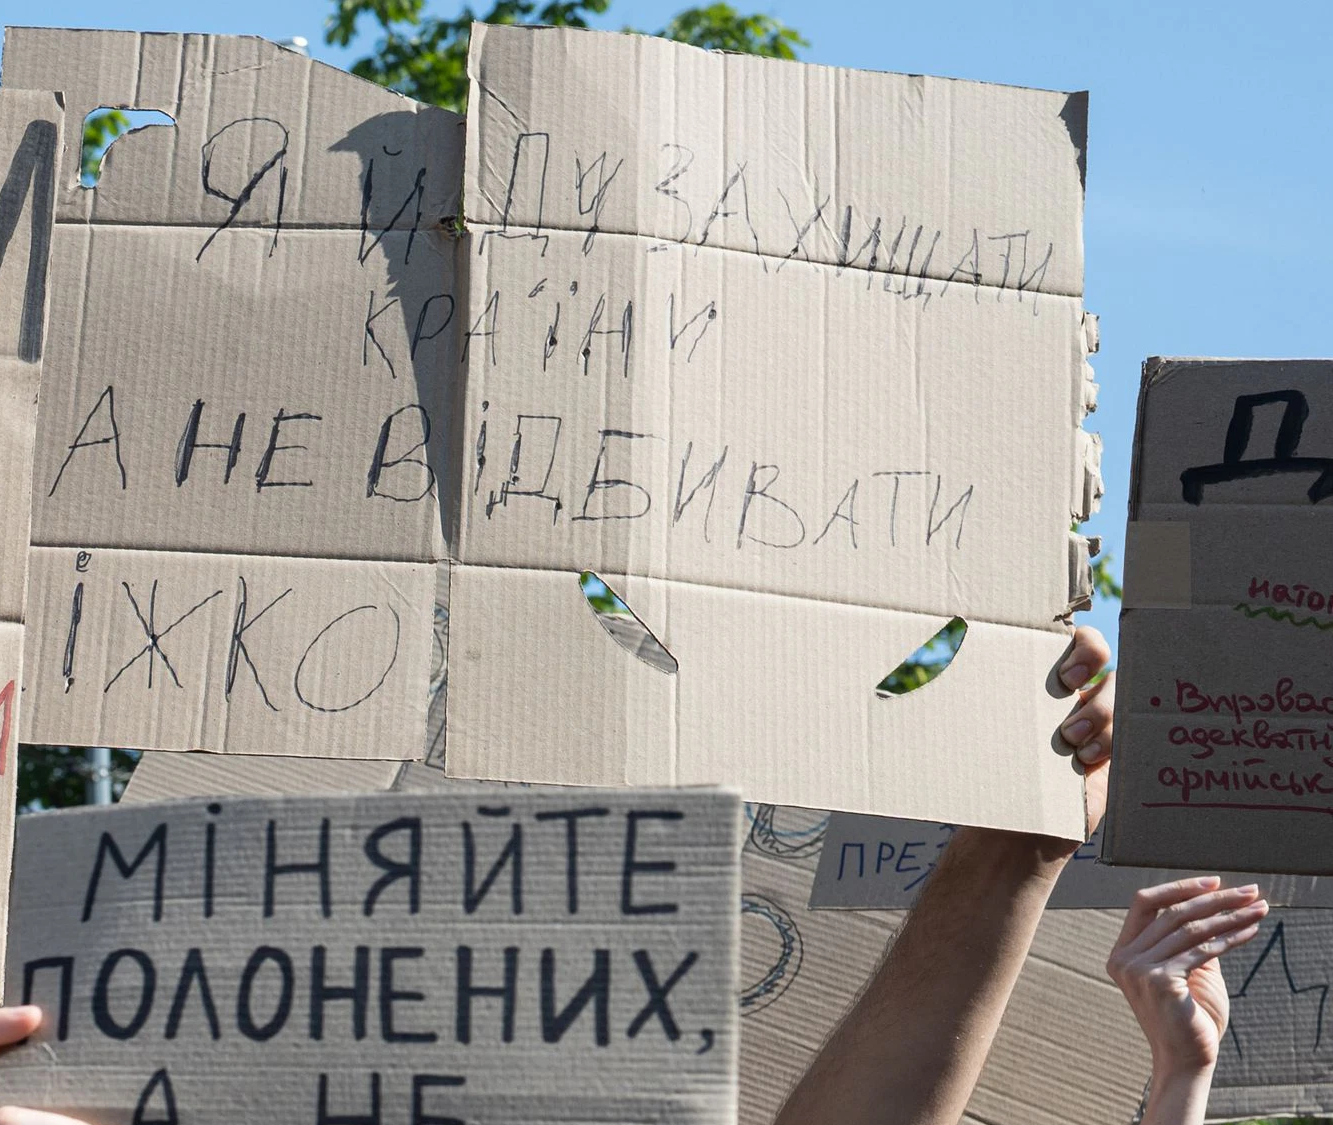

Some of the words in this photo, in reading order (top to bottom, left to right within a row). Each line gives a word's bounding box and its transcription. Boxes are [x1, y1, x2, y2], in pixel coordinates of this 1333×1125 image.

[197, 117, 290, 262] Я
[48, 385, 128, 497] А
[175, 400, 322, 493] НЕ
[22, 945, 718, 1054] ПОЛОНЕНИХ,
